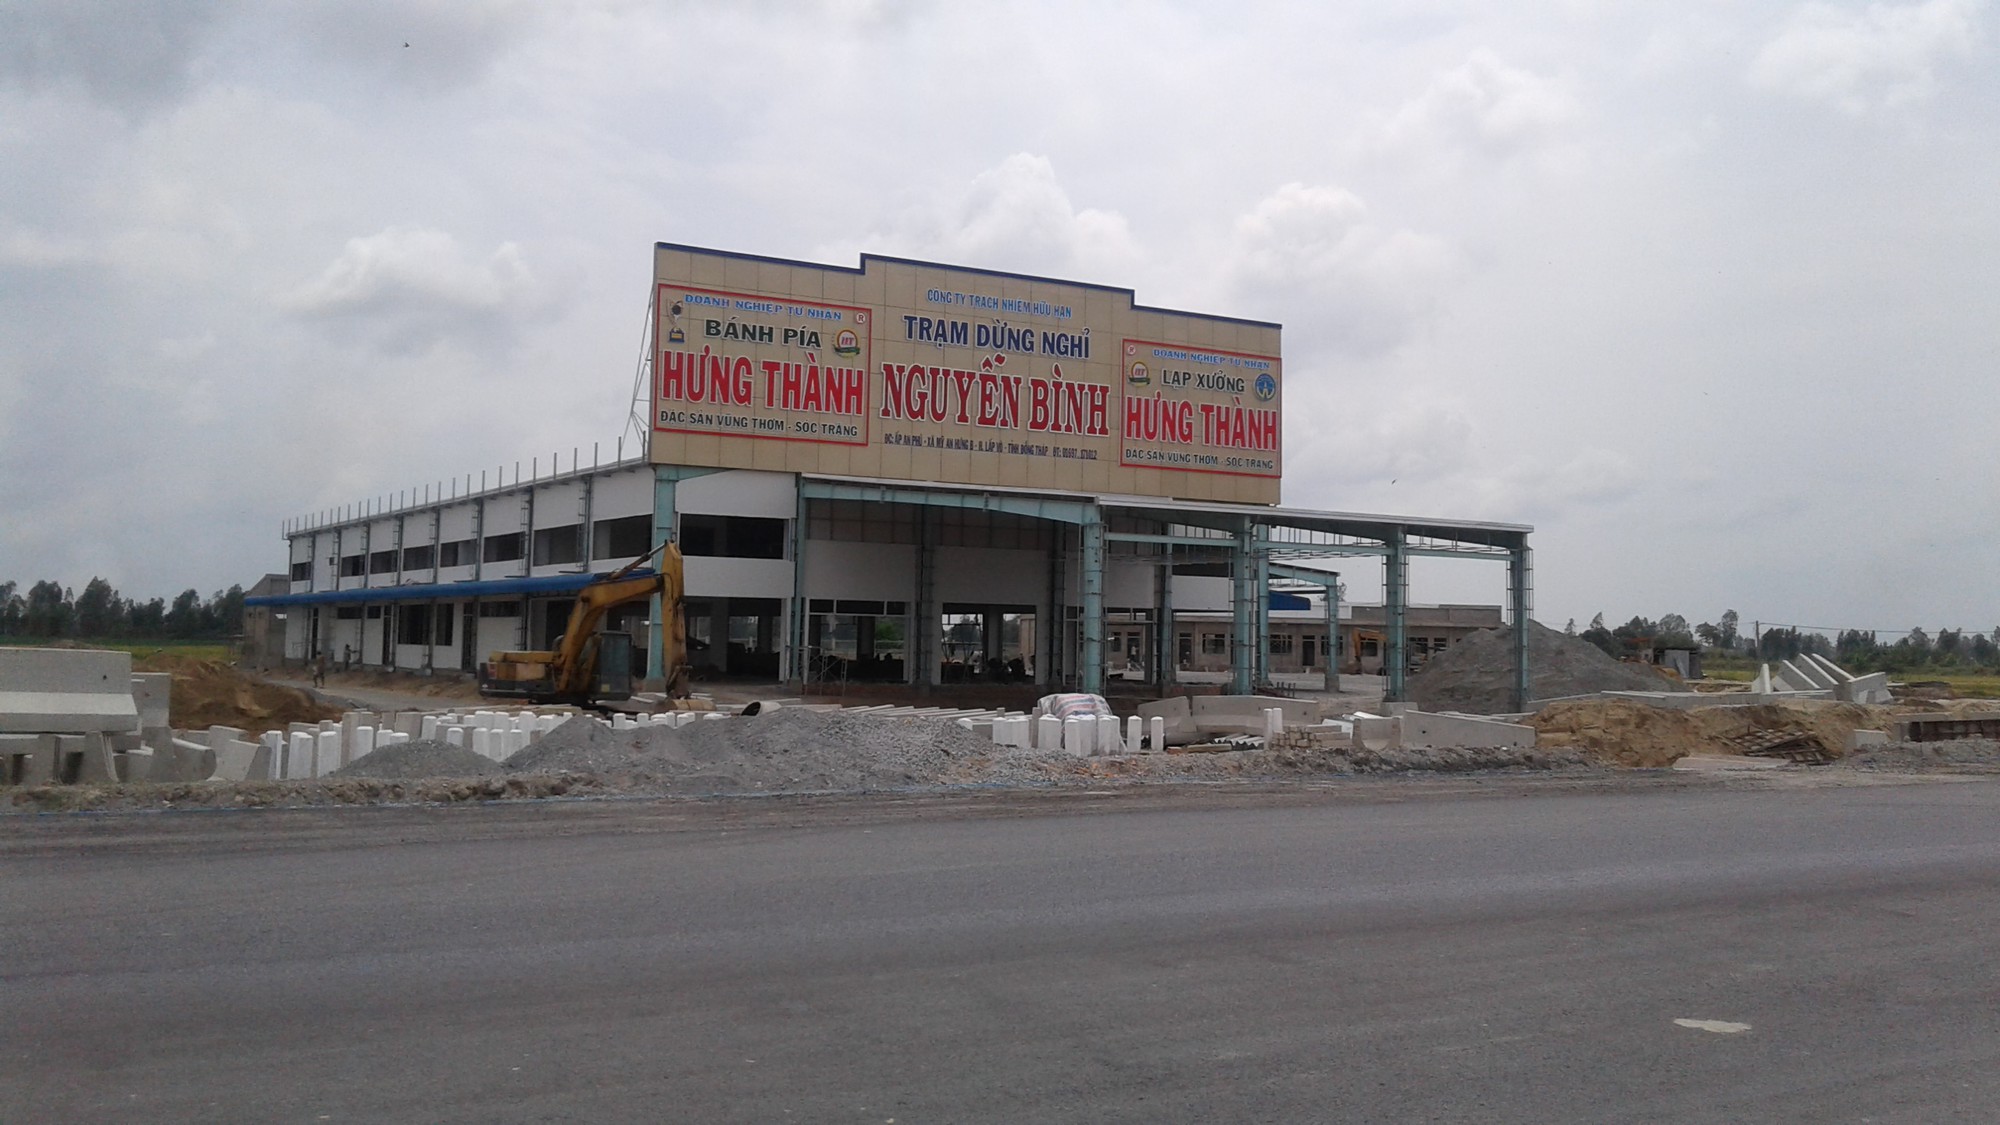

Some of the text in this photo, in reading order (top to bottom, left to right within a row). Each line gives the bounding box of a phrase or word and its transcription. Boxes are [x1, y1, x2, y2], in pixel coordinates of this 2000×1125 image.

[684, 294, 730, 308] DOANH
[954, 293, 967, 305] TY
[705, 316, 822, 348] BÁNH PÍA
[903, 315, 1091, 359] TRẠM DỪNG NGHỈ
[1153, 349, 1187, 360] DOANH
[661, 344, 864, 416] HƯNG THÀNH
[1162, 369, 1245, 393] LẠP XƯỞNG
[880, 353, 1110, 436] NGUYỄN BÌNH
[690, 409, 713, 425] SẢN
[752, 417, 784, 431] THƠM
[1125, 391, 1277, 451] HƯNG THÀNH
